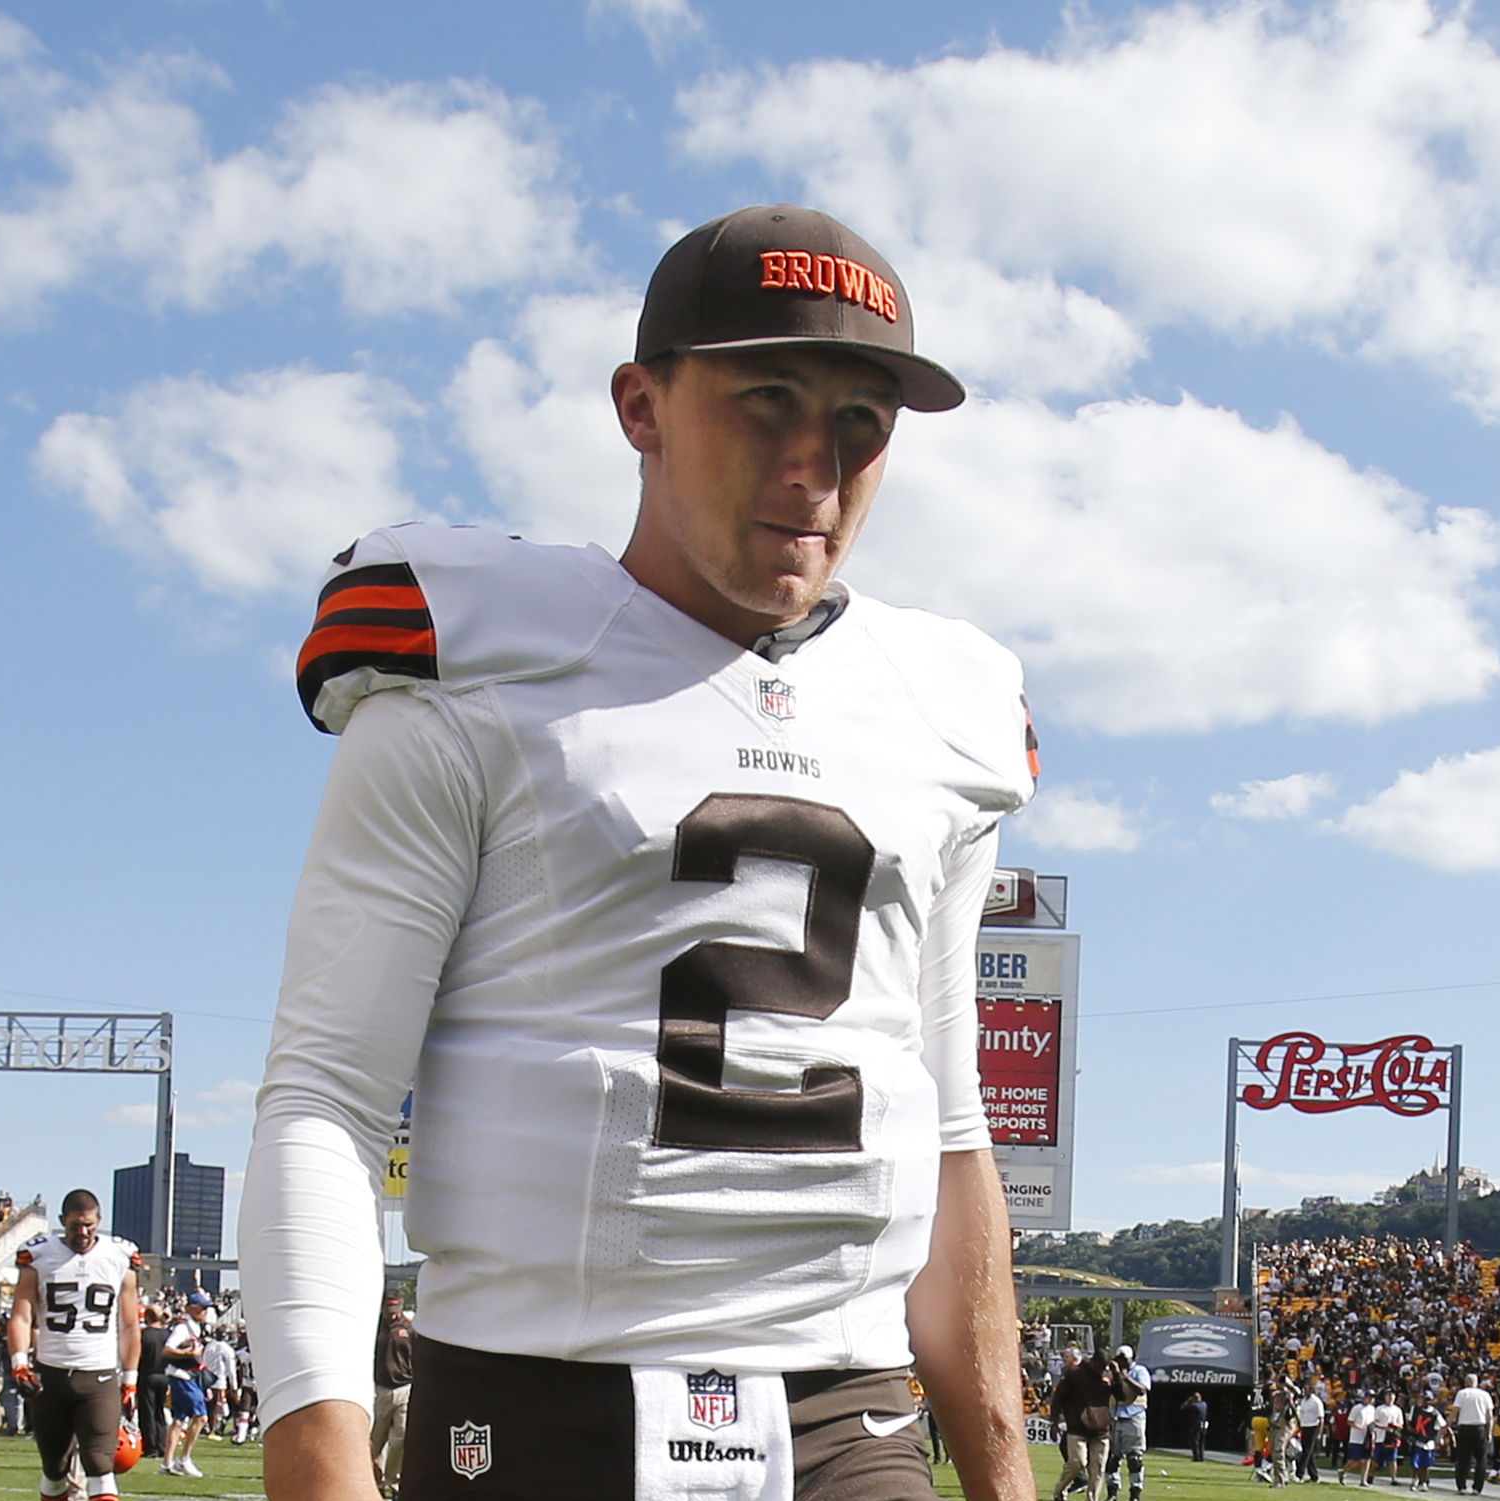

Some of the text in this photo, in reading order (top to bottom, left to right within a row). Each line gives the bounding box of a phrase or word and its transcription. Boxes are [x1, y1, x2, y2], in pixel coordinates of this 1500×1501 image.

[760, 250, 898, 324] BROWNS
[764, 693, 793, 716] NFL
[736, 748, 821, 779] BROWNS
[652, 792, 876, 1153] 2
[976, 953, 1027, 979] BER
[1001, 1087, 1048, 1101] HOME
[985, 1103, 1047, 1115] THE MOST
[989, 1116, 1047, 1130] SPORTS
[45, 1282, 115, 1333] 59
[693, 1394, 735, 1425] NFL
[1027, 1428, 1047, 1441] 99
[1415, 1415, 1433, 1437] K
[457, 1446, 486, 1469] NFL
[668, 1441, 756, 1462] Wilson
